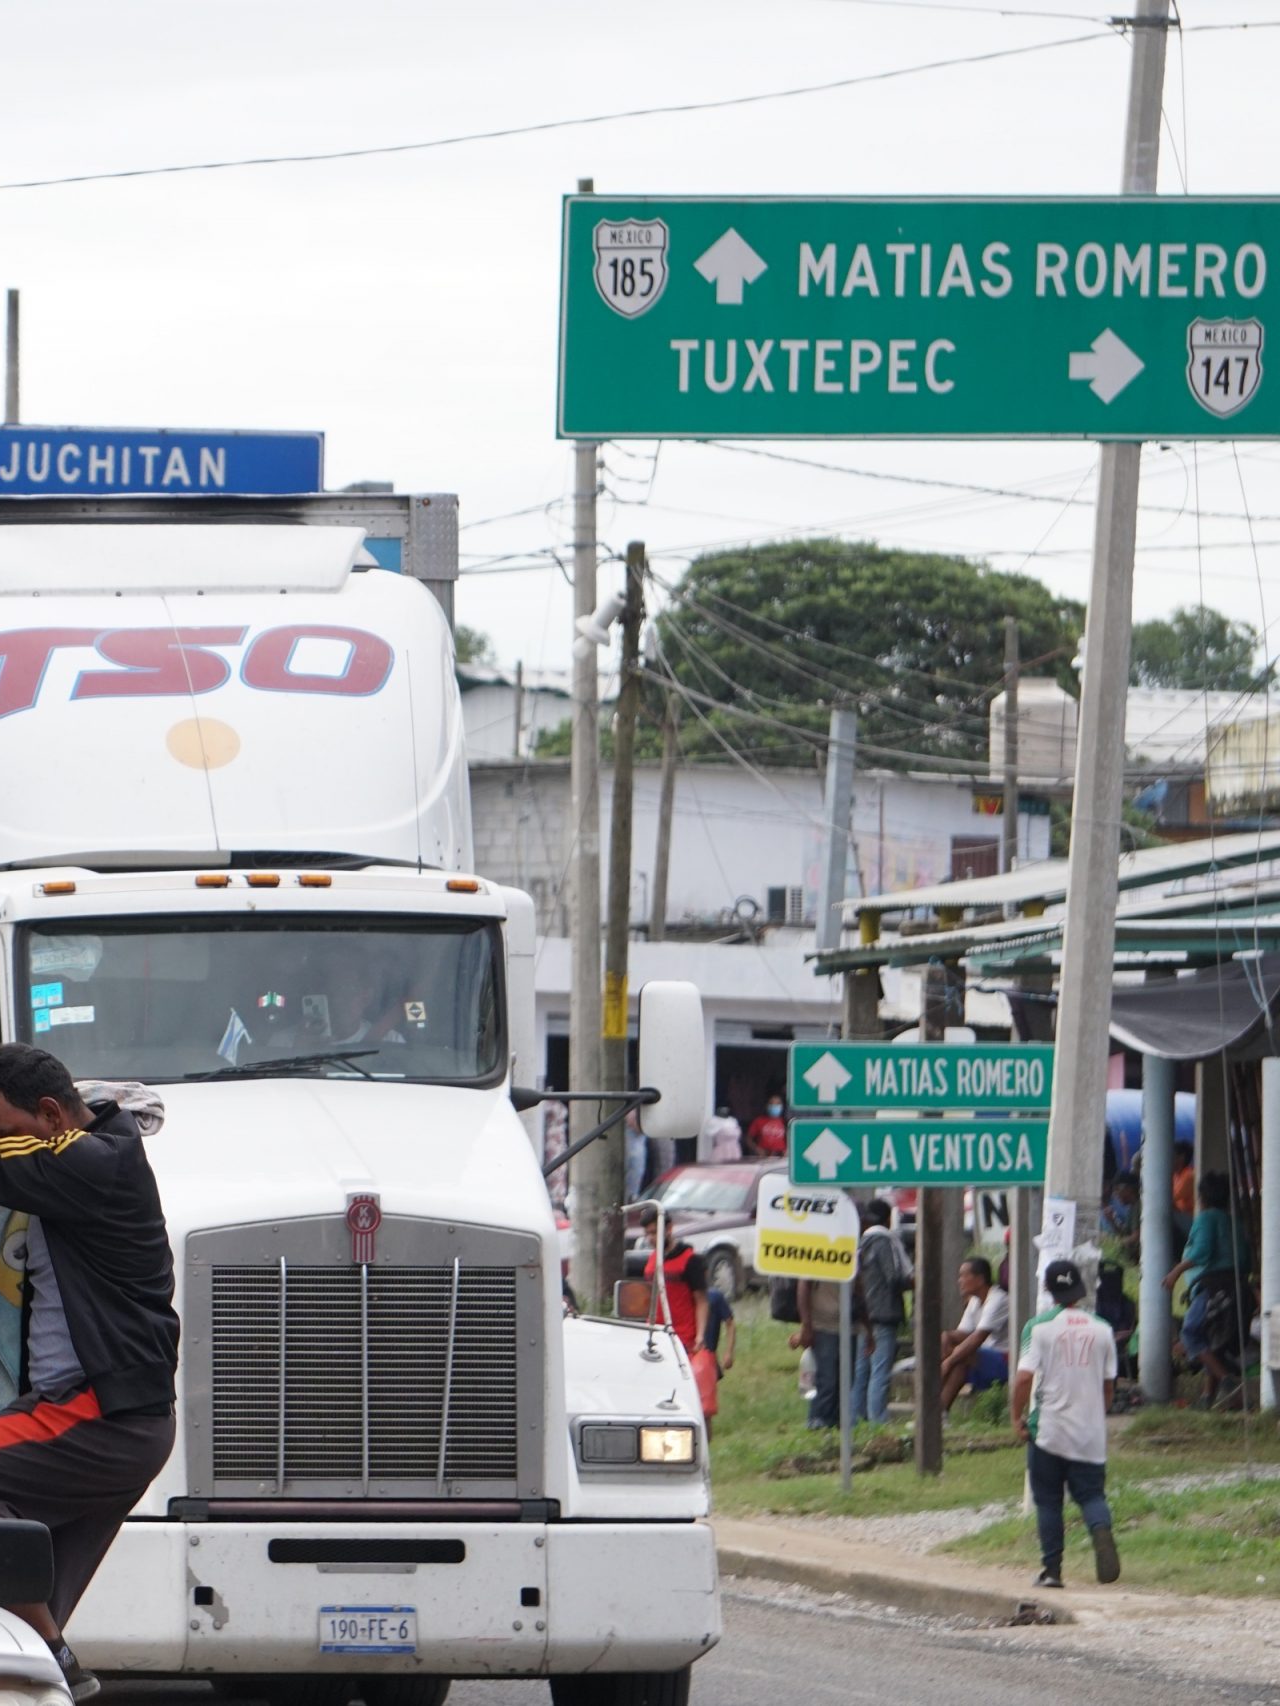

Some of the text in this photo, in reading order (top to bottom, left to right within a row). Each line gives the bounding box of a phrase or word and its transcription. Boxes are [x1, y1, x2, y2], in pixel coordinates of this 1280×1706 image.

[610, 229, 652, 245] MEXICO
[609, 257, 655, 297] 185
[798, 242, 1267, 298] MATIAS ROMERO
[1204, 326, 1248, 344] MEXICO
[670, 339, 956, 393] TUXTEPEC
[1201, 357, 1250, 396] 147
[865, 1058, 1044, 1096] MATIAS ROMERO
[862, 1133, 1033, 1171] LA VENTOSA
[762, 1243, 852, 1265] TORNADO
[331, 1618, 408, 1640] 190-FE-6
